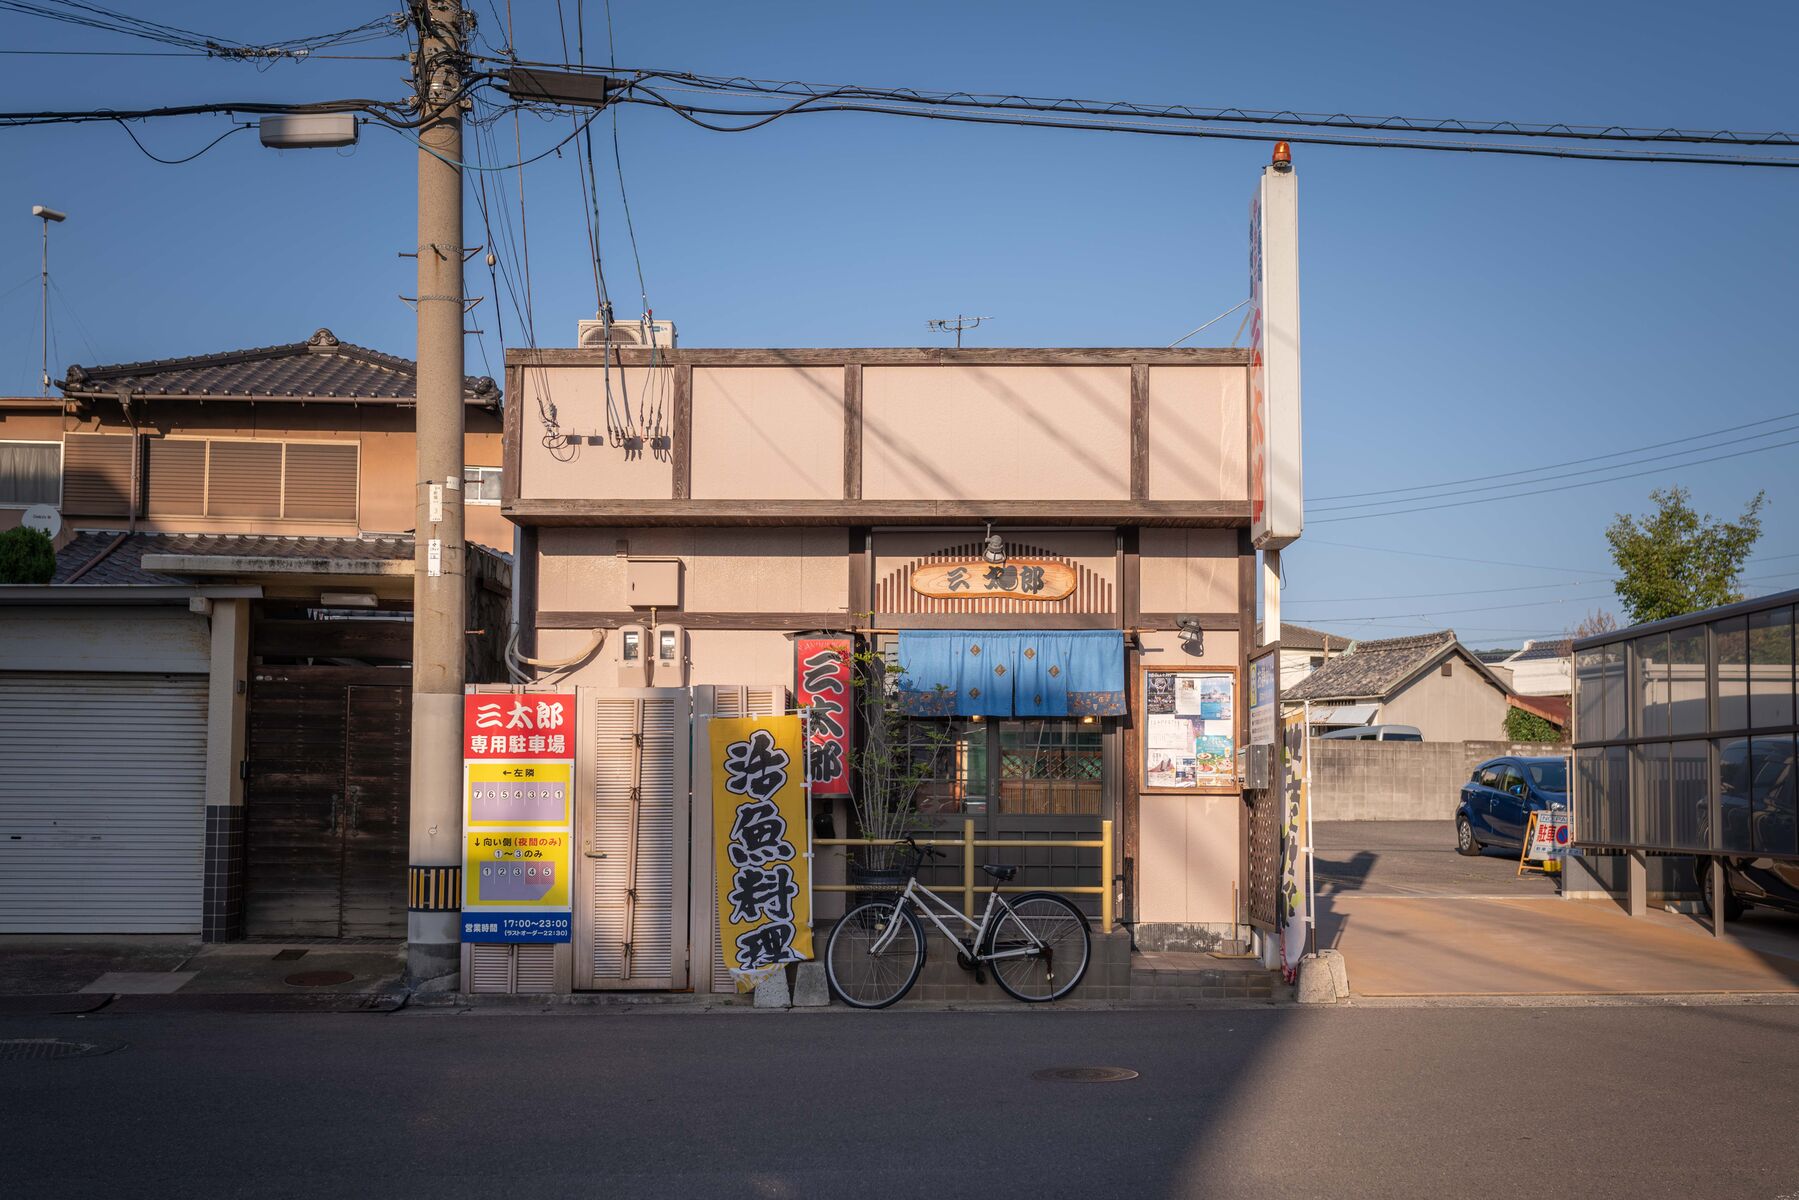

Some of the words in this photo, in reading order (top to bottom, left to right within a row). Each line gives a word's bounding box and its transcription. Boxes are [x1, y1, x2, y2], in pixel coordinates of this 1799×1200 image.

[476, 701, 564, 730] 三太郎
[470, 734, 566, 754] 専用駐車場
[513, 768, 535, 778] 左隣
[1537, 824, 1556, 843] 駐車
[723, 729, 800, 971] 活魚料理
[464, 923, 498, 933] 営業時間
